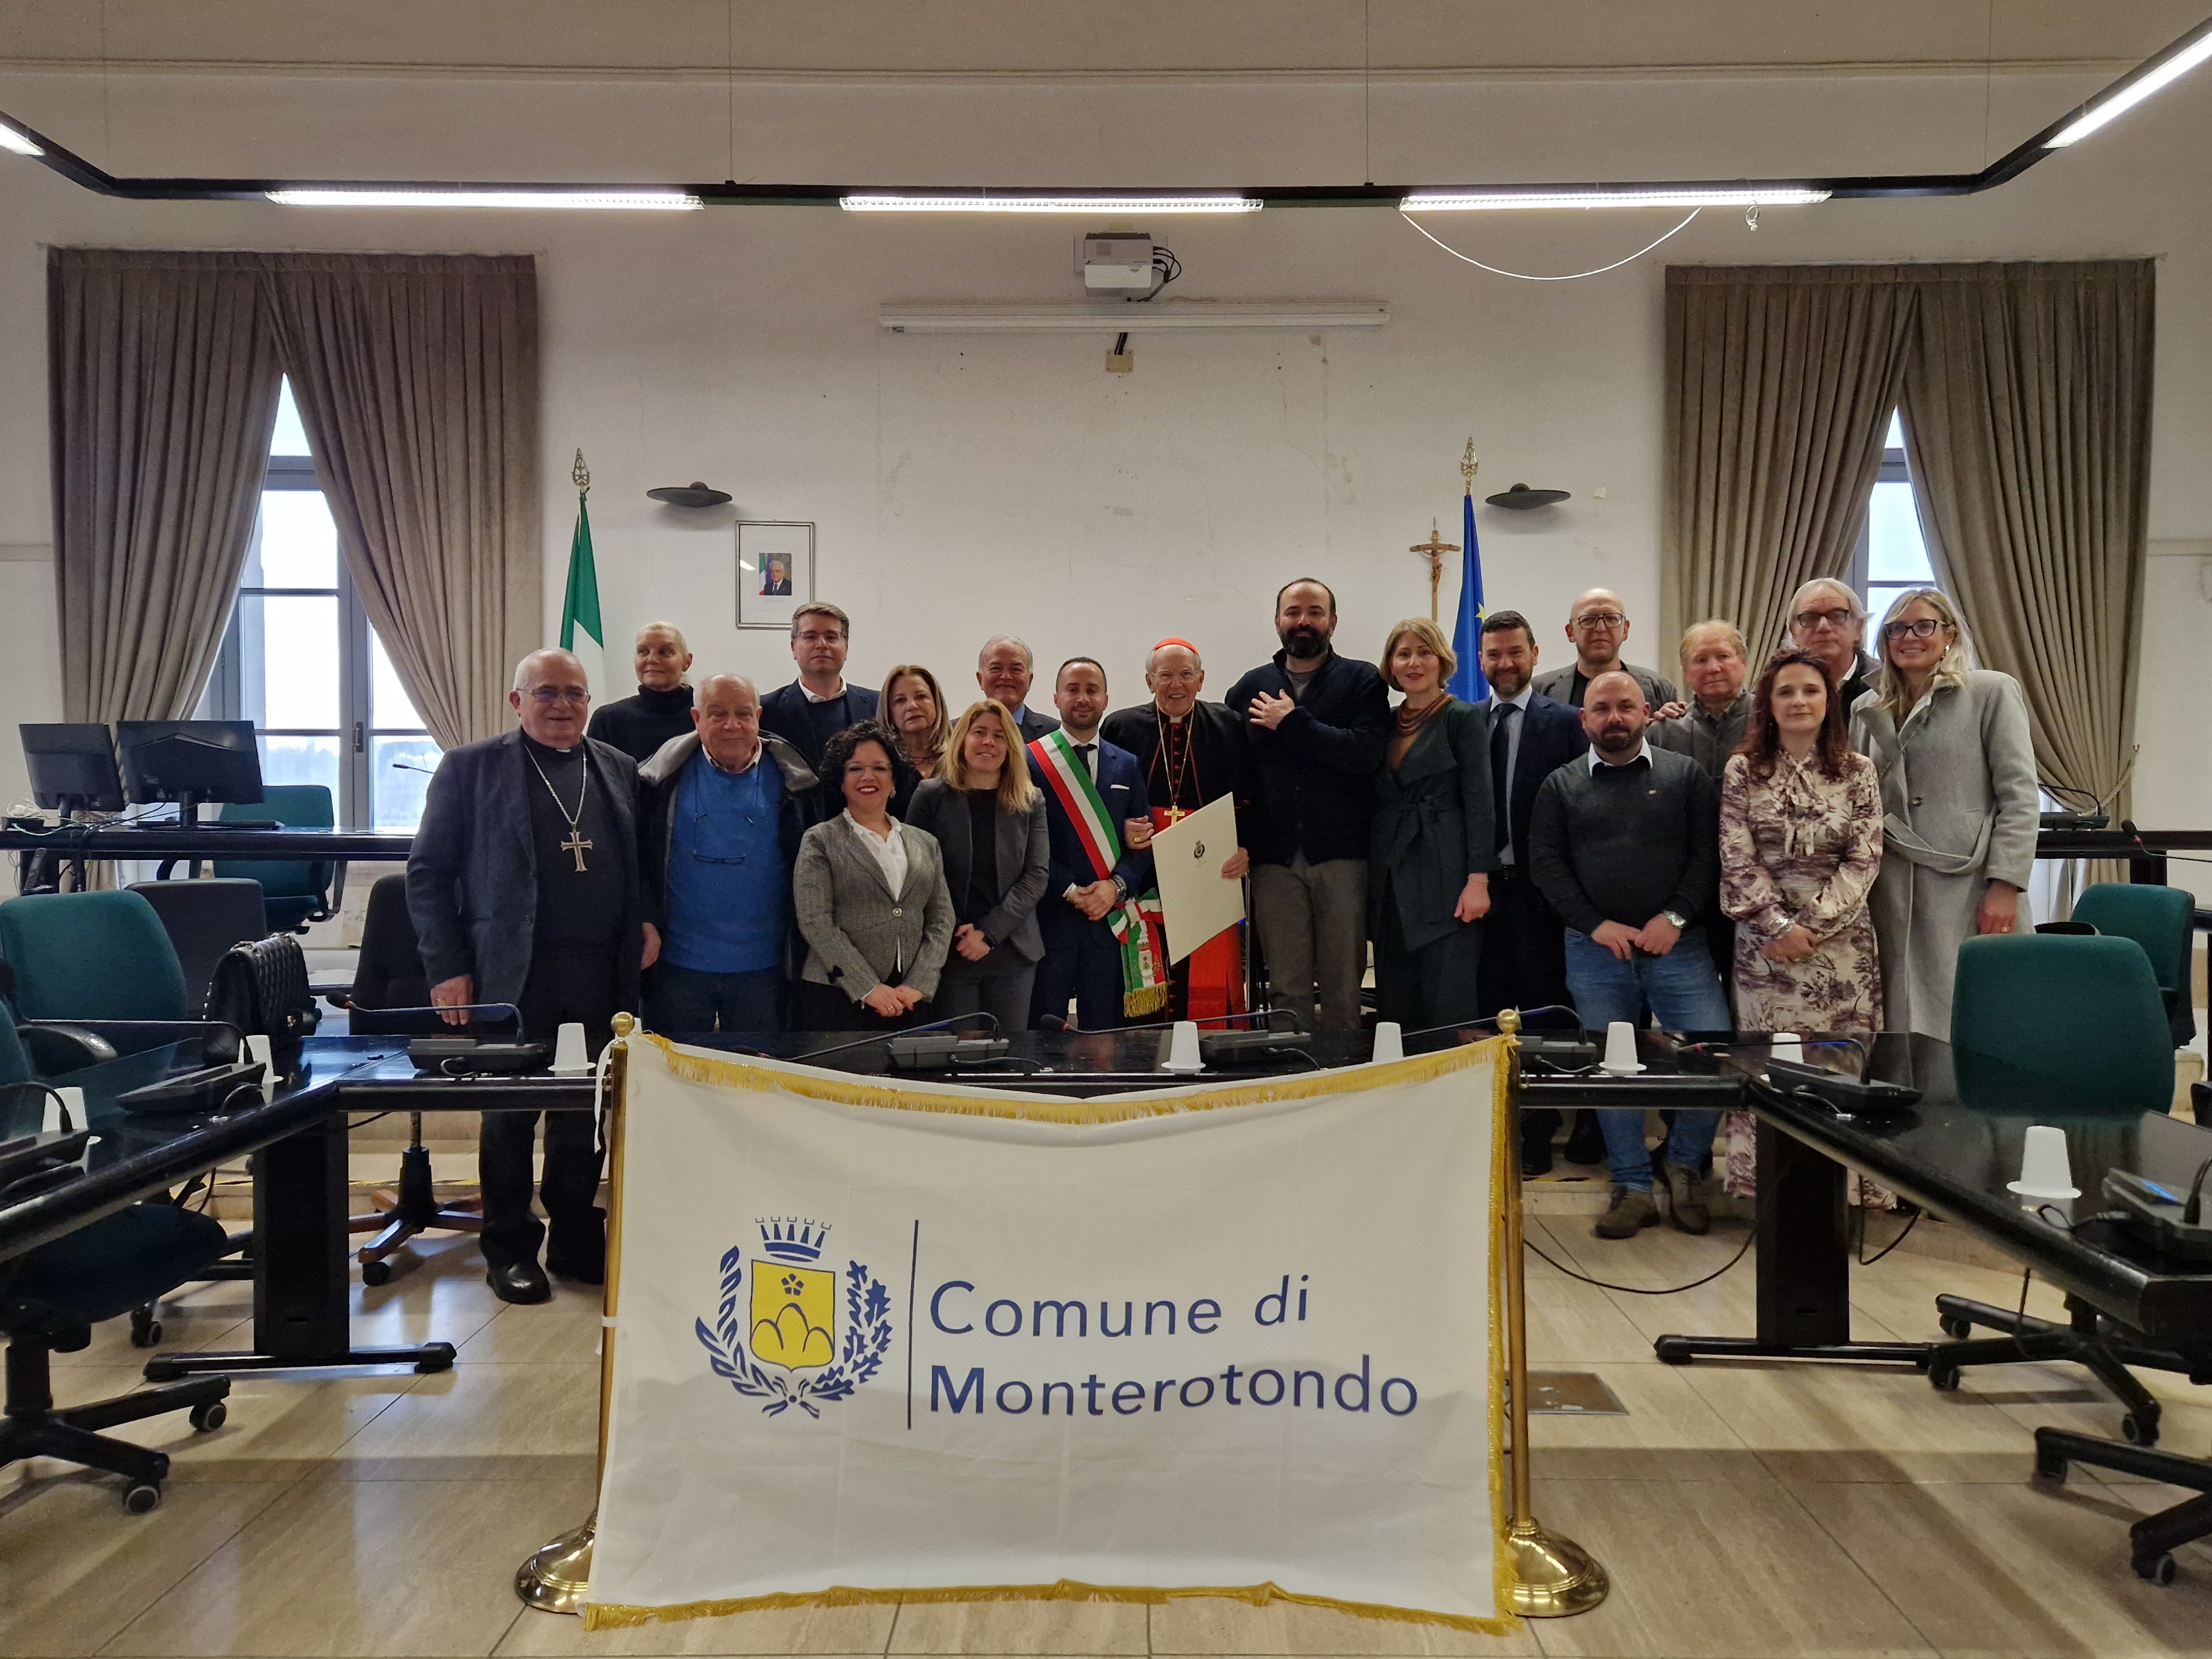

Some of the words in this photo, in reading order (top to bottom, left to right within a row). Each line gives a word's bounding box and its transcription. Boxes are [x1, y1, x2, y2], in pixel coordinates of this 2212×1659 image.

[930, 1280, 1222, 1337] Comune
[1255, 1274, 1309, 1326] di
[930, 1354, 1419, 1416] Monterotondo
